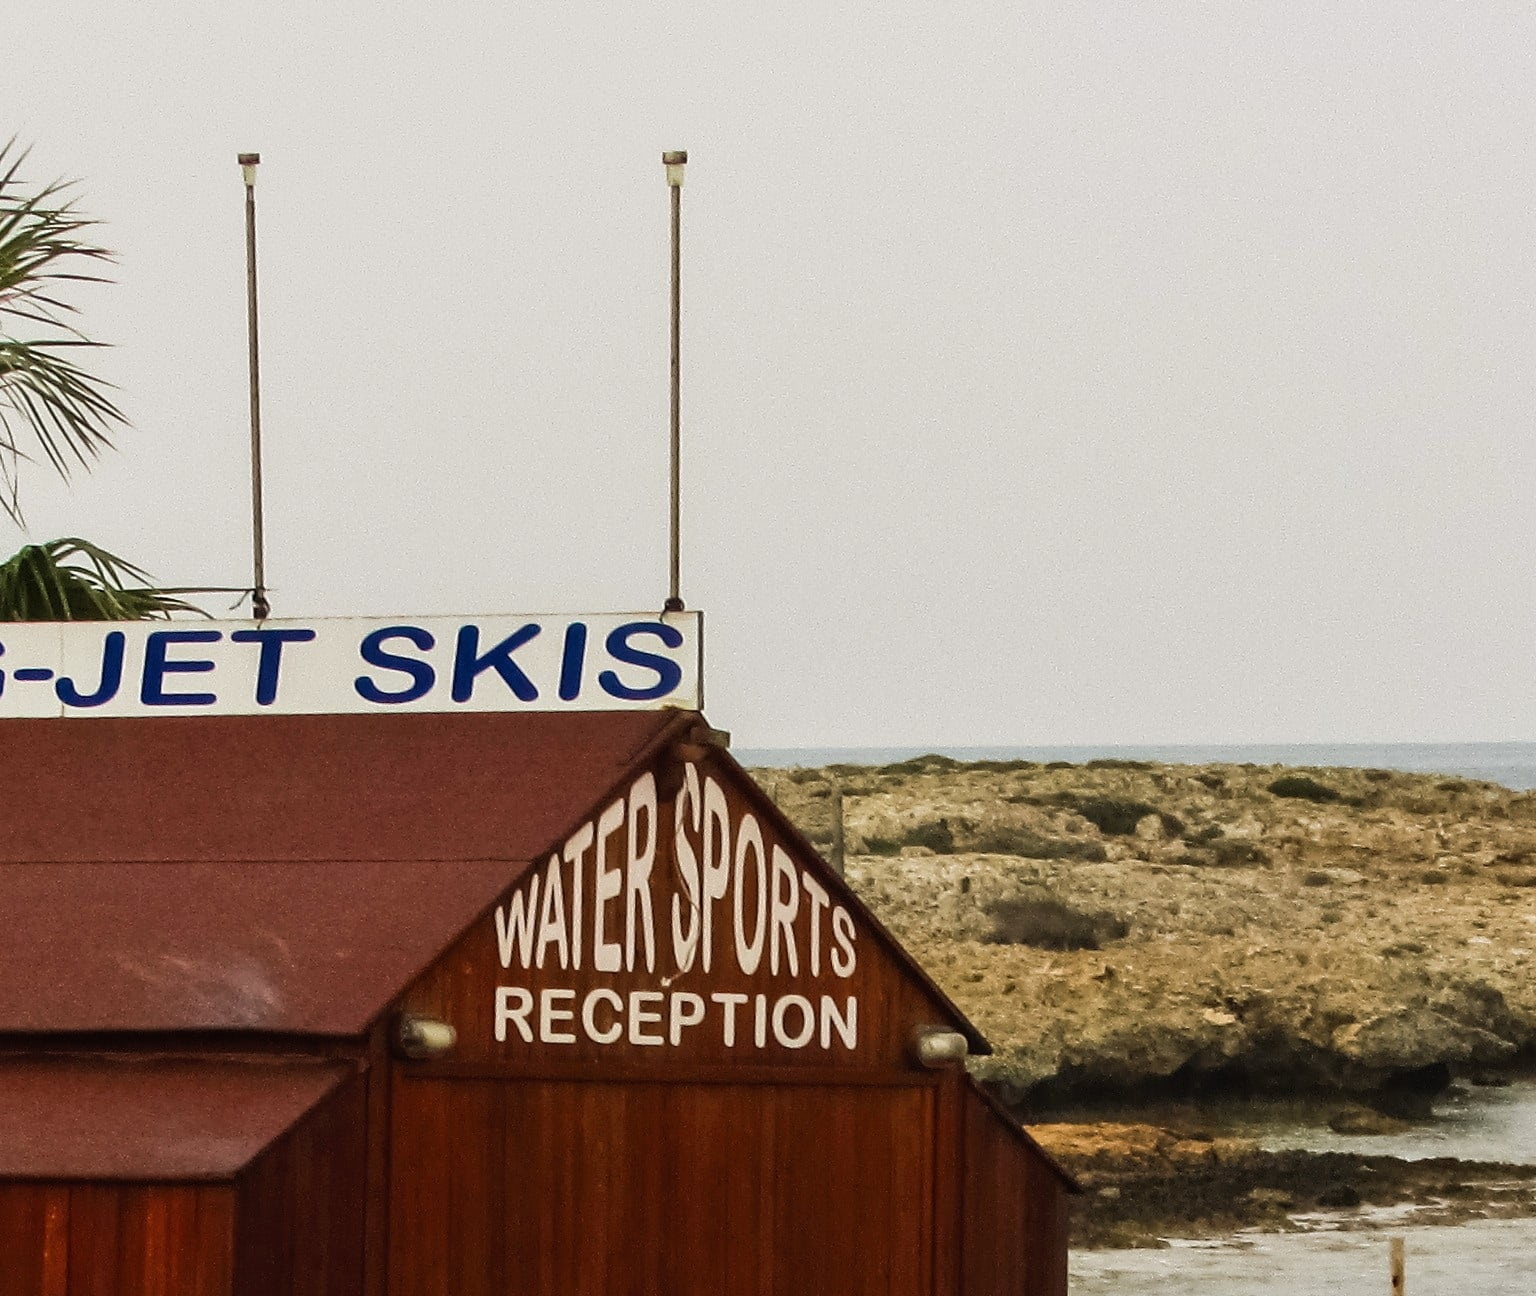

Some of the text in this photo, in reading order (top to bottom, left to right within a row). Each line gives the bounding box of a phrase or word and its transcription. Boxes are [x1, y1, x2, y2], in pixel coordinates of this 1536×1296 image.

[353, 620, 686, 704] SKIS
[494, 761, 859, 980] WATER SPORTS
[494, 986, 858, 1051] RECEPTION
